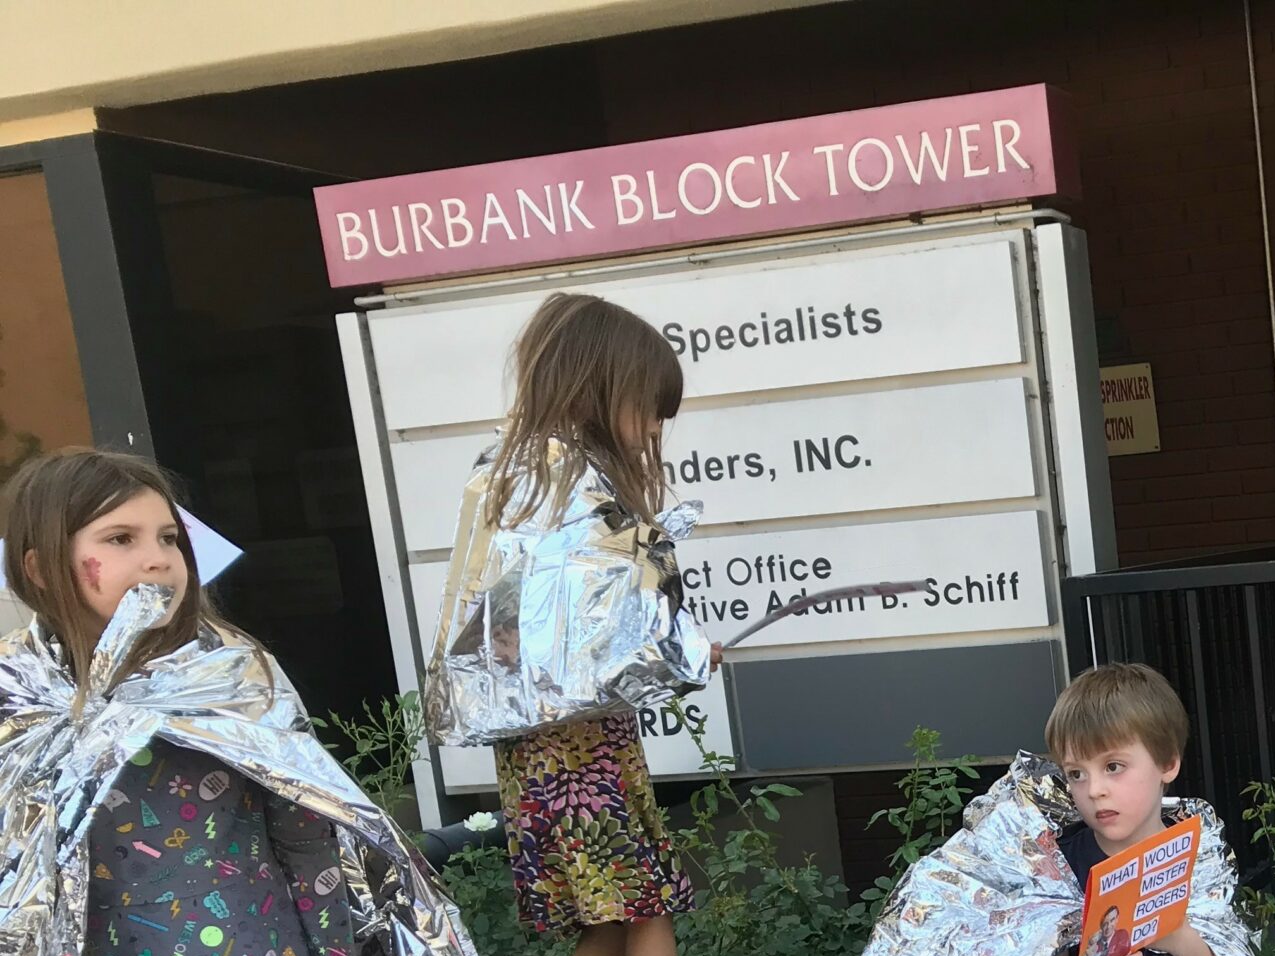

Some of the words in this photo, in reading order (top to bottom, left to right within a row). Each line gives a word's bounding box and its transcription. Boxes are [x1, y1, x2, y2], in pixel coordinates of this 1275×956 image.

[334, 180, 596, 263] BURBANK
[610, 150, 801, 227] BLOCK
[812, 118, 1031, 197] TOWER
[662, 303, 883, 362] Specialists
[1100, 376, 1151, 404] SPRINKLER
[1105, 416, 1134, 441] CTION
[663, 448, 777, 485] nders,
[793, 434, 873, 473] INC.
[726, 553, 832, 587] Office
[765, 587, 866, 617] Adam
[880, 581, 908, 610] B.
[924, 571, 1019, 608] Schiff
[638, 704, 703, 738] RDS
[203, 773, 226, 796] Hi!
[318, 870, 339, 890] Hi!
[1101, 861, 1137, 892] WHAT
[1144, 836, 1191, 869] WOULD
[1141, 861, 1187, 892] MISTER
[1136, 884, 1186, 917] ROGERS
[1133, 919, 1158, 942] DO?
